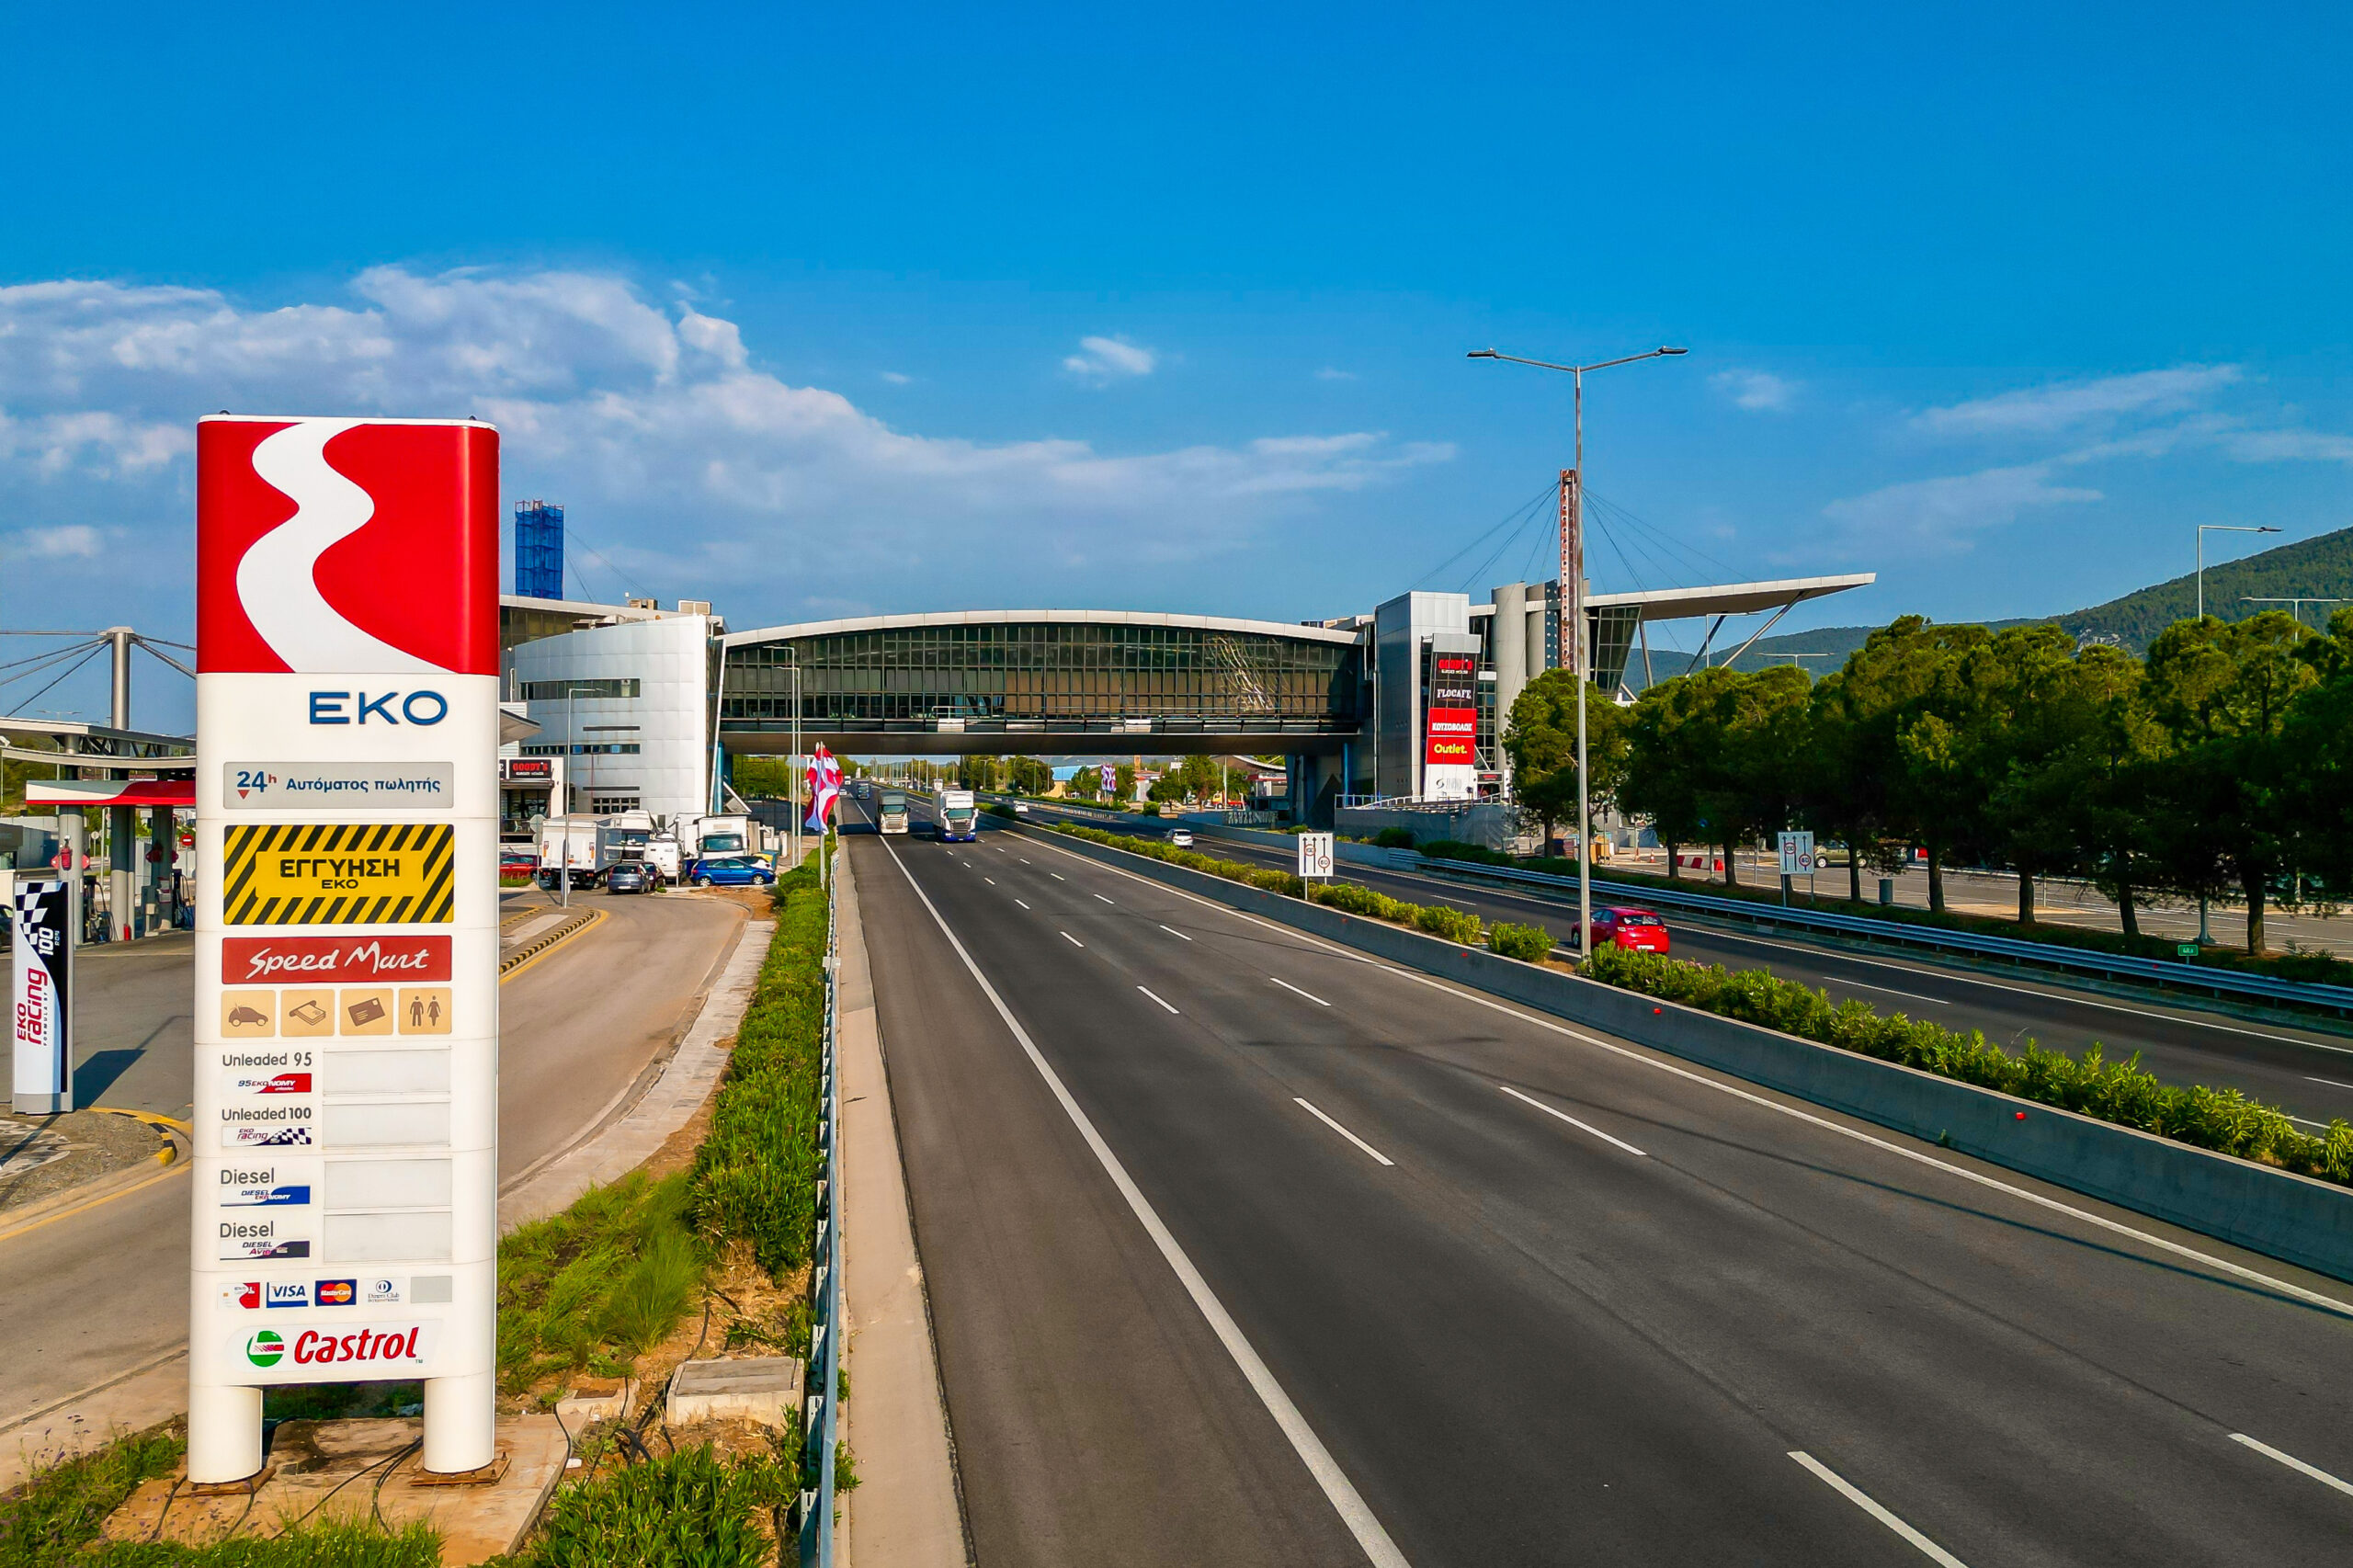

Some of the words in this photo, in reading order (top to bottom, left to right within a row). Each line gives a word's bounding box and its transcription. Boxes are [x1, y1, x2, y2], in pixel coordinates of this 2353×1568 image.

[309, 690, 449, 726] EKO
[286, 777, 369, 793] Αυτόματος
[374, 777, 441, 793] πωλητής
[279, 858, 400, 878] ΕΓΓΥΗΣΗ
[321, 879, 359, 890] EKO
[39, 926, 54, 956] 100
[244, 947, 340, 980] Speed
[344, 939, 430, 974] Mart
[27, 967, 49, 1045] racing
[17, 1002, 27, 1041] EKO
[222, 1052, 288, 1067] Unleaded
[293, 1051, 313, 1067] 95
[222, 1107, 287, 1121] Unleaded
[289, 1107, 313, 1119] 100
[221, 1166, 275, 1185] Diesel
[220, 1220, 274, 1238] Diesel
[272, 1285, 306, 1298] VISA
[294, 1326, 420, 1364] Castrol
